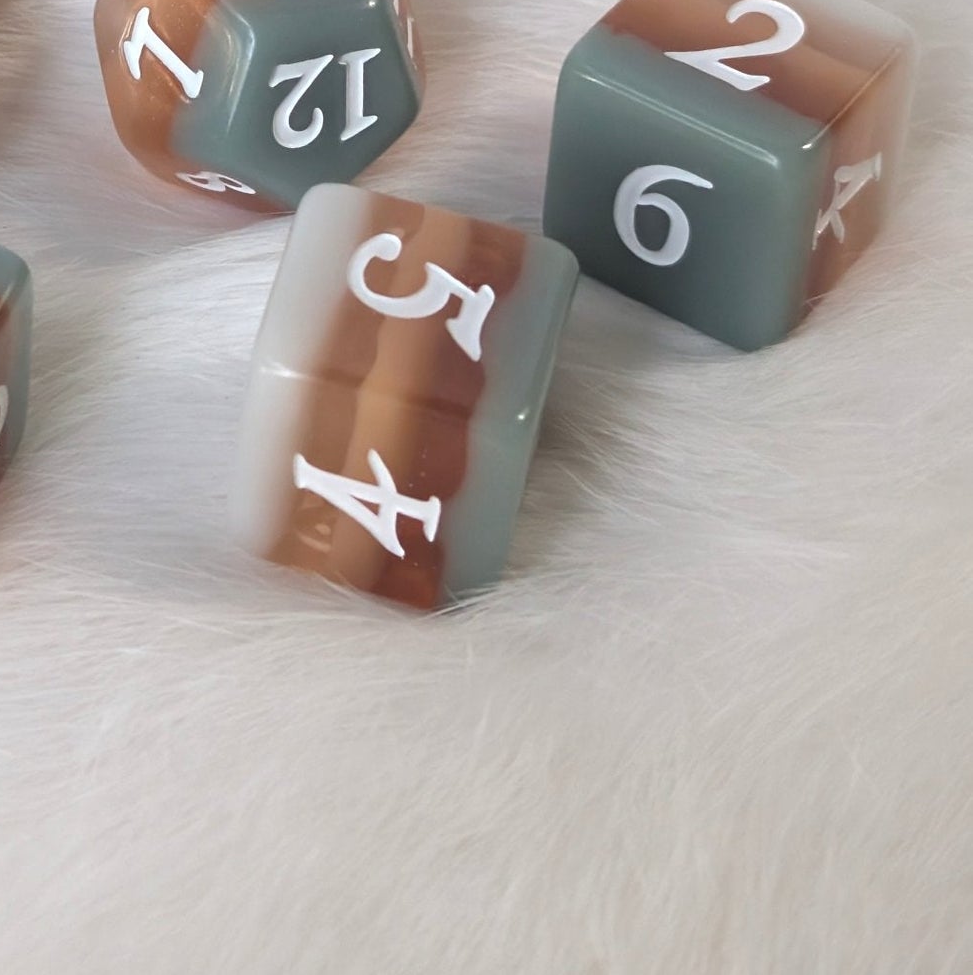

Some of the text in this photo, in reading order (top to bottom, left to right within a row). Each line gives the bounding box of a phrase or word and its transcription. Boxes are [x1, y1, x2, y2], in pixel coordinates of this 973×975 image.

[123, 7, 204, 99] 7
[268, 48, 381, 148] 12
[613, 164, 713, 267] 6
[812, 152, 882, 250] 4
[347, 233, 495, 362] 5
[293, 448, 441, 558] 4
